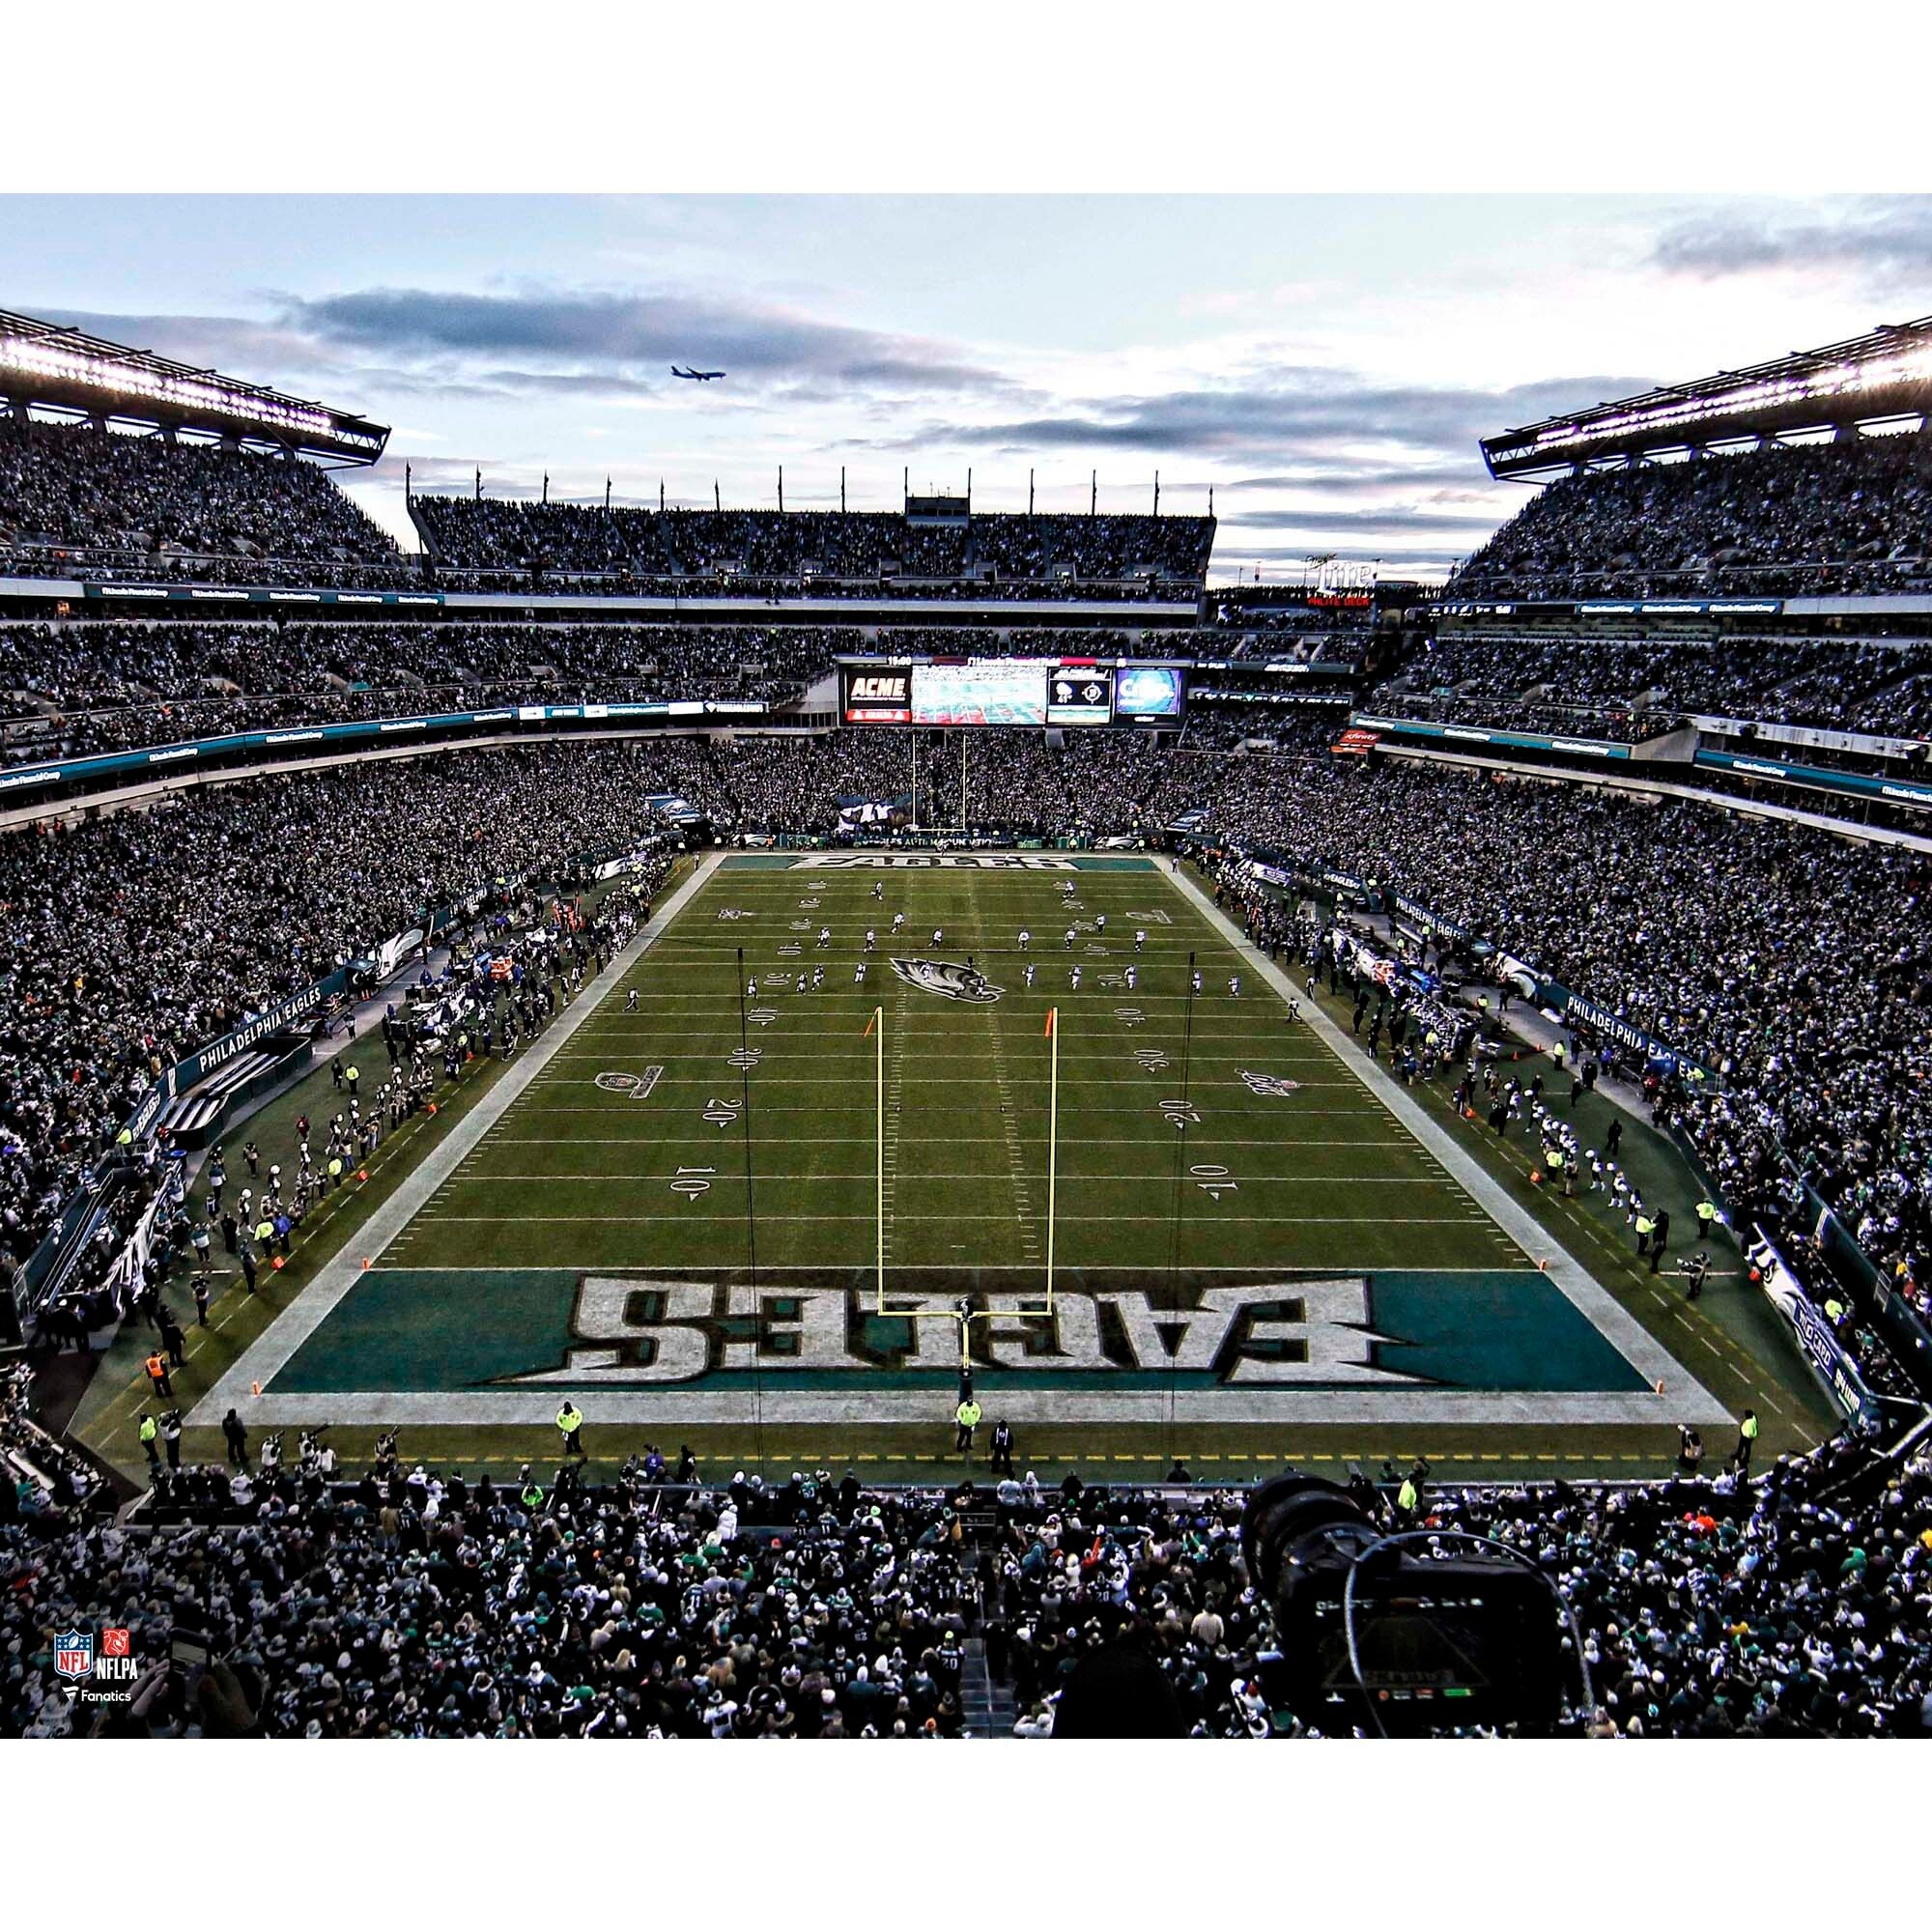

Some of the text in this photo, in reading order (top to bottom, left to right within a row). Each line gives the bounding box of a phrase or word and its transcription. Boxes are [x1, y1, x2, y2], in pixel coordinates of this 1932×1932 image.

[199, 986, 322, 1072] PHILADELPHIA EAGLES
[1567, 996, 1644, 1049] PHILADELPHIA
[726, 1047, 763, 1066] 30
[1133, 1049, 1170, 1068] 30
[701, 1097, 743, 1122] 20
[1158, 1099, 1202, 1123] 20
[669, 1165, 717, 1192] 10
[1189, 1164, 1239, 1191] 10
[483, 1274, 1432, 1384] EAGLES
